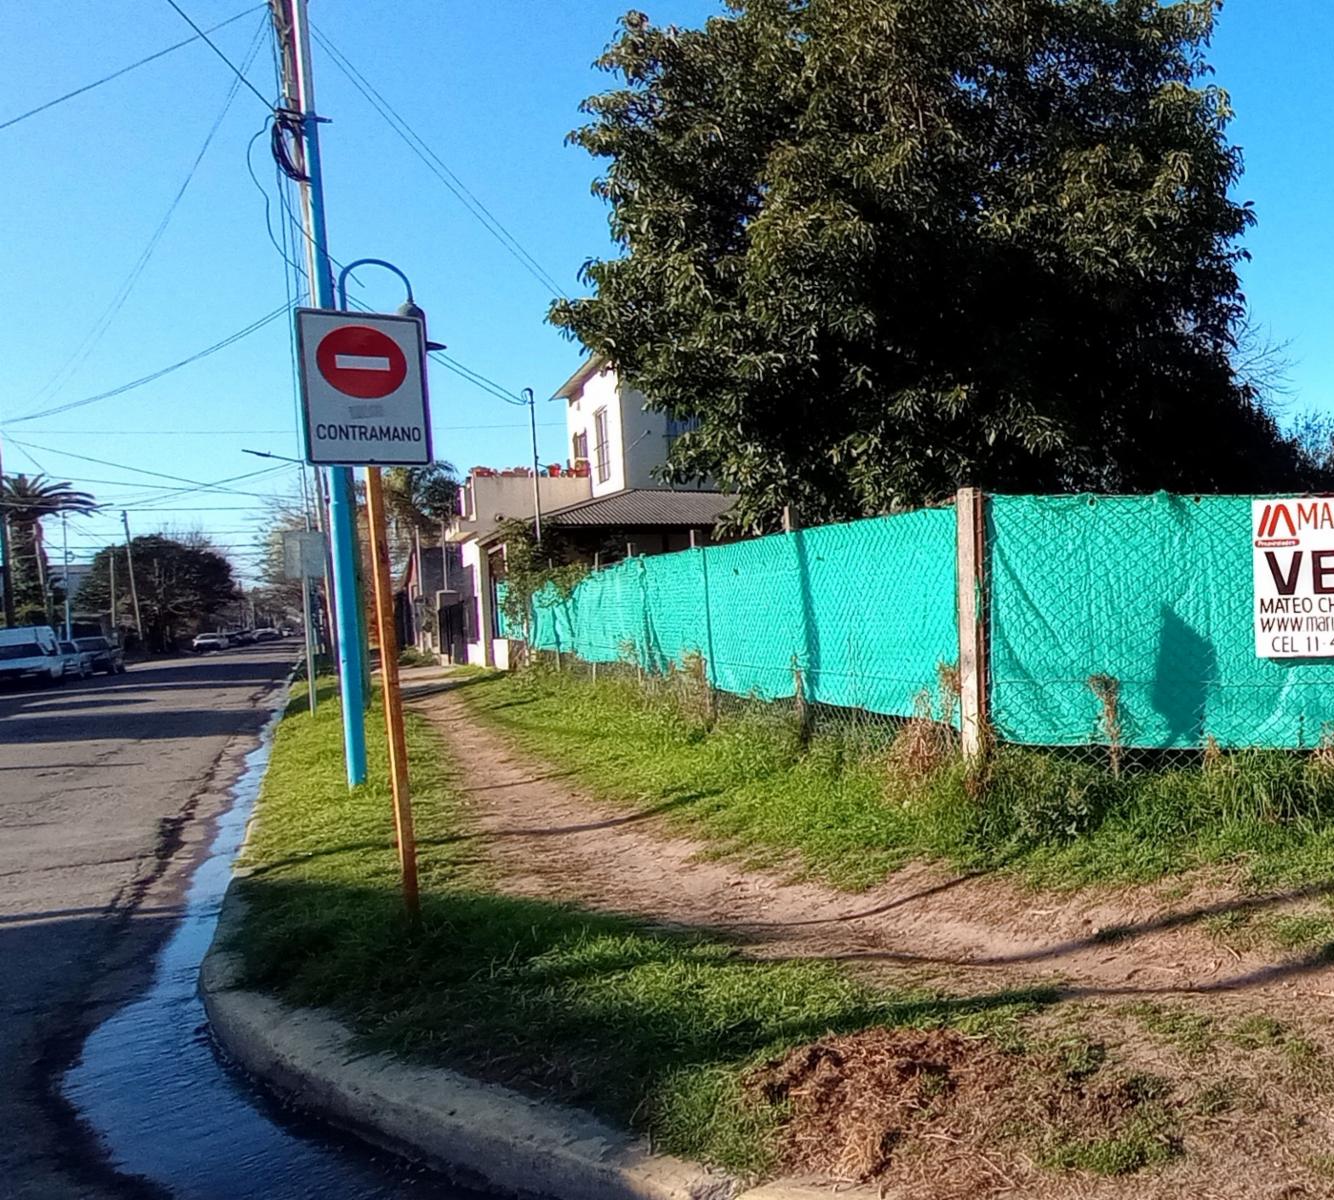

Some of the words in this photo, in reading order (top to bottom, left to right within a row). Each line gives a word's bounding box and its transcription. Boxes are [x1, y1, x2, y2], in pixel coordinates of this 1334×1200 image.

[315, 424, 422, 442] CONTRAMANO
[1260, 597, 1313, 614] MATEO
[1271, 636, 1299, 653] CEL
